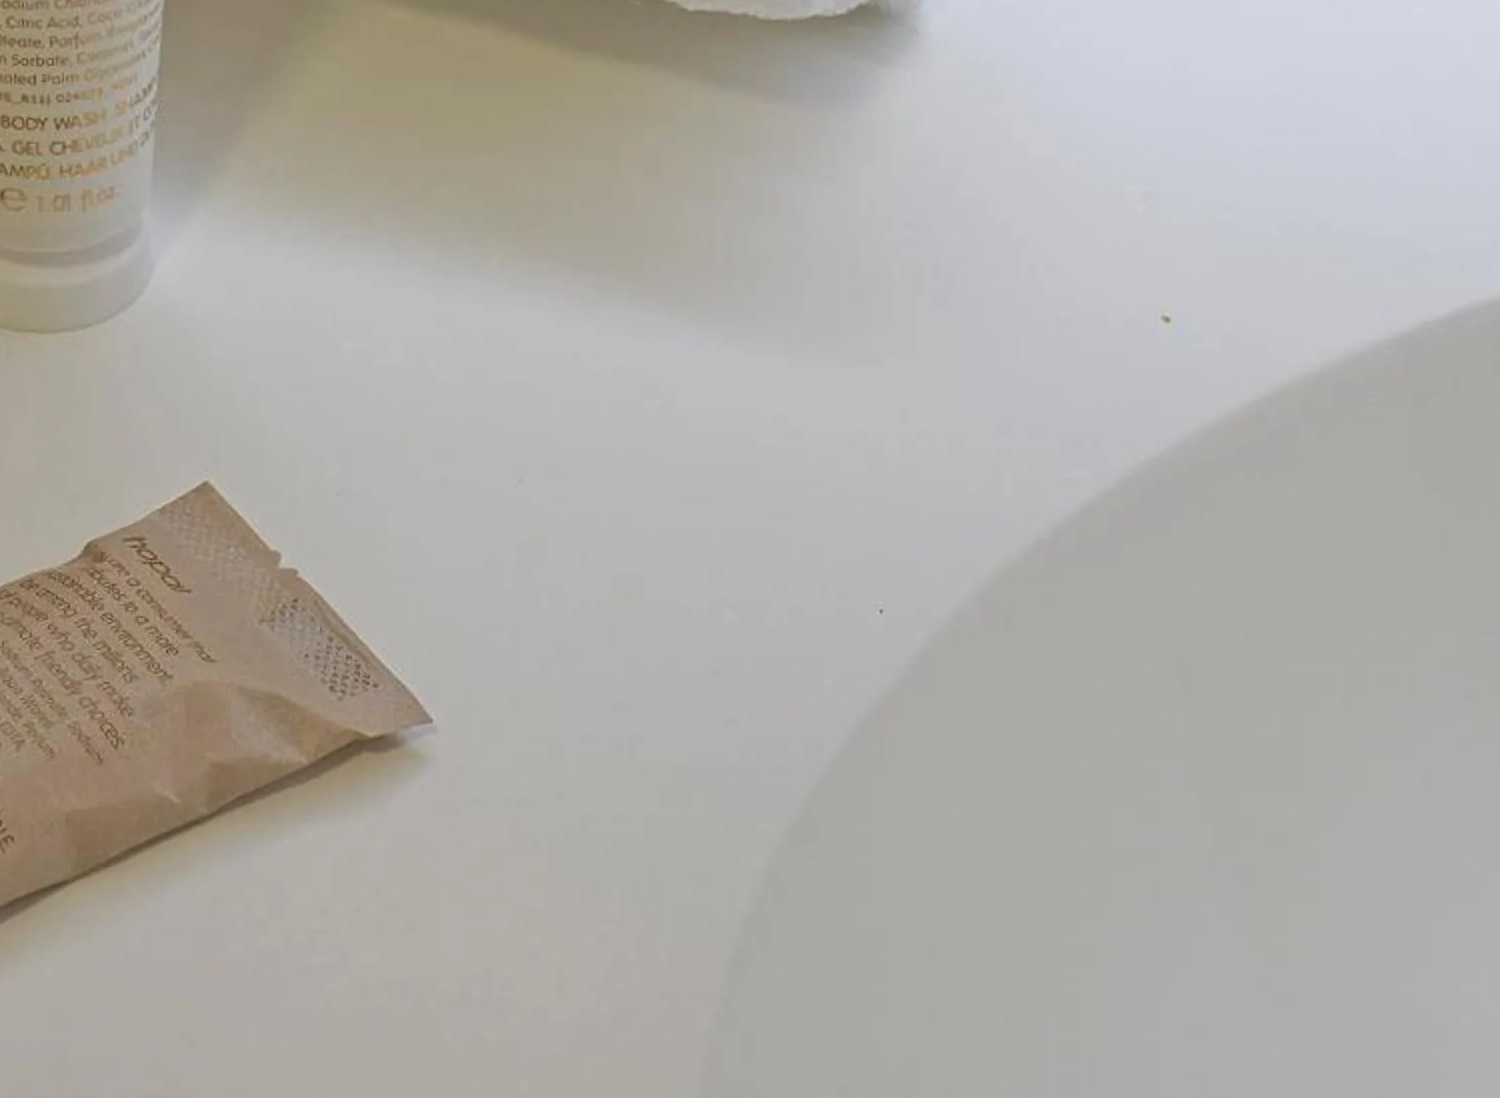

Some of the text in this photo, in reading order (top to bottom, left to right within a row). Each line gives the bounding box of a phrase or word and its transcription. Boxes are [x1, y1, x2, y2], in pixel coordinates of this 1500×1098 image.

[0, 115, 49, 132] BODY
[11, 140, 44, 156] GEL
[122, 536, 191, 592] hopal
[145, 626, 178, 655] more
